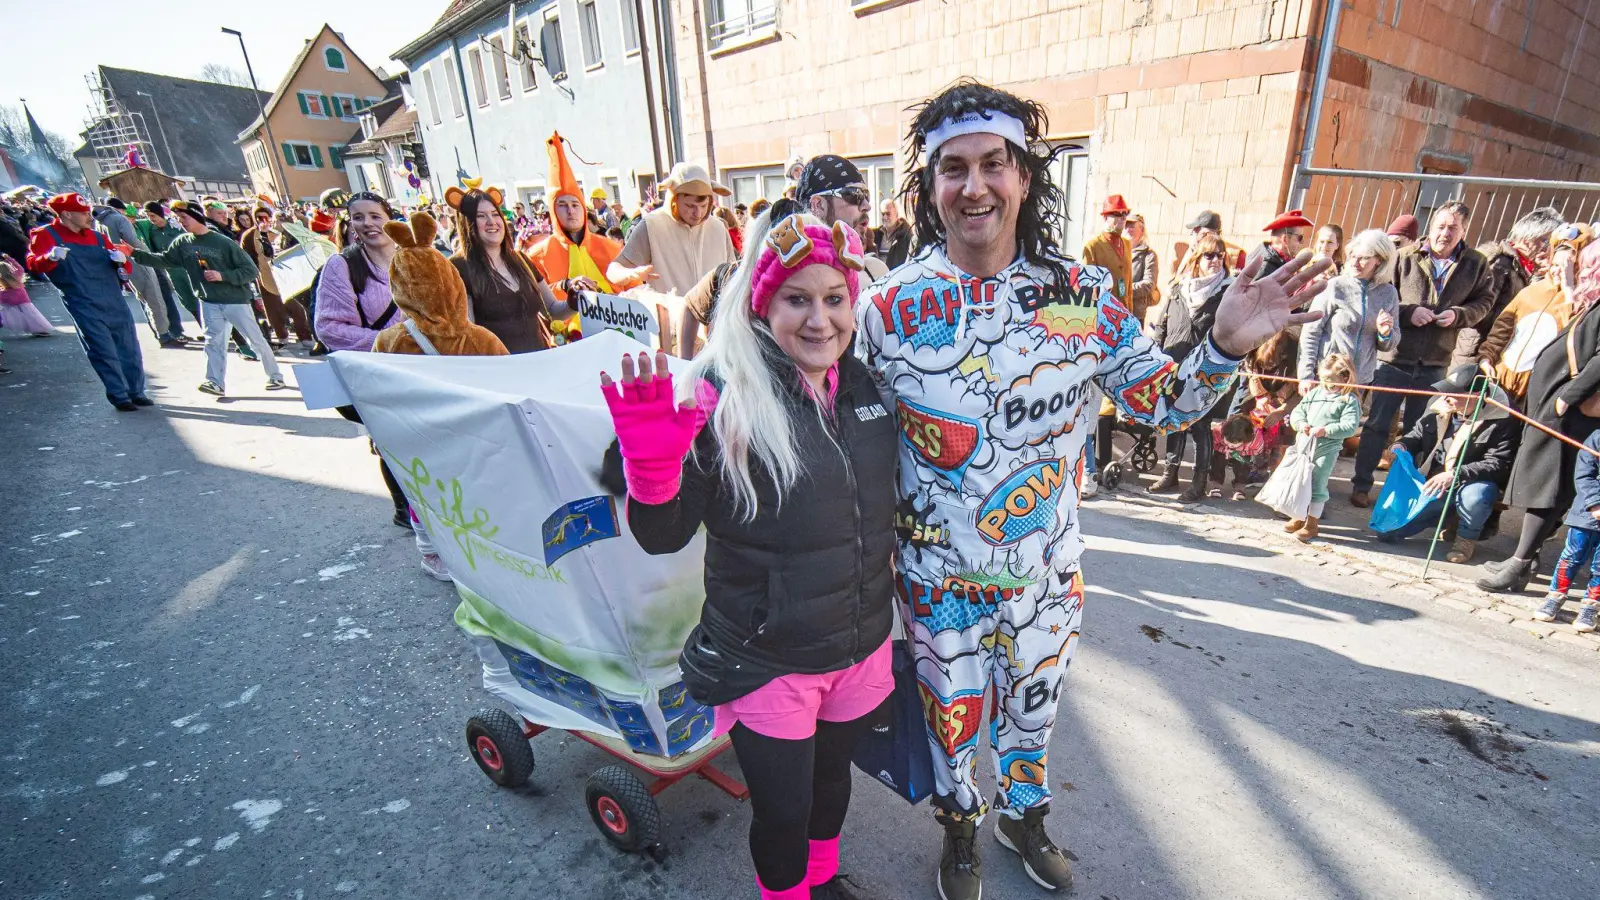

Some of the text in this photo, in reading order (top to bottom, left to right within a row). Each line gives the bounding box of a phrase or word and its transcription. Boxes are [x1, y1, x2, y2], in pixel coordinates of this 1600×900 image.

[871, 284, 995, 338] YEAH!!
[899, 408, 943, 458] YES
[975, 455, 1067, 543] POW
[893, 511, 952, 546] LASH!
[918, 684, 968, 748] YES
